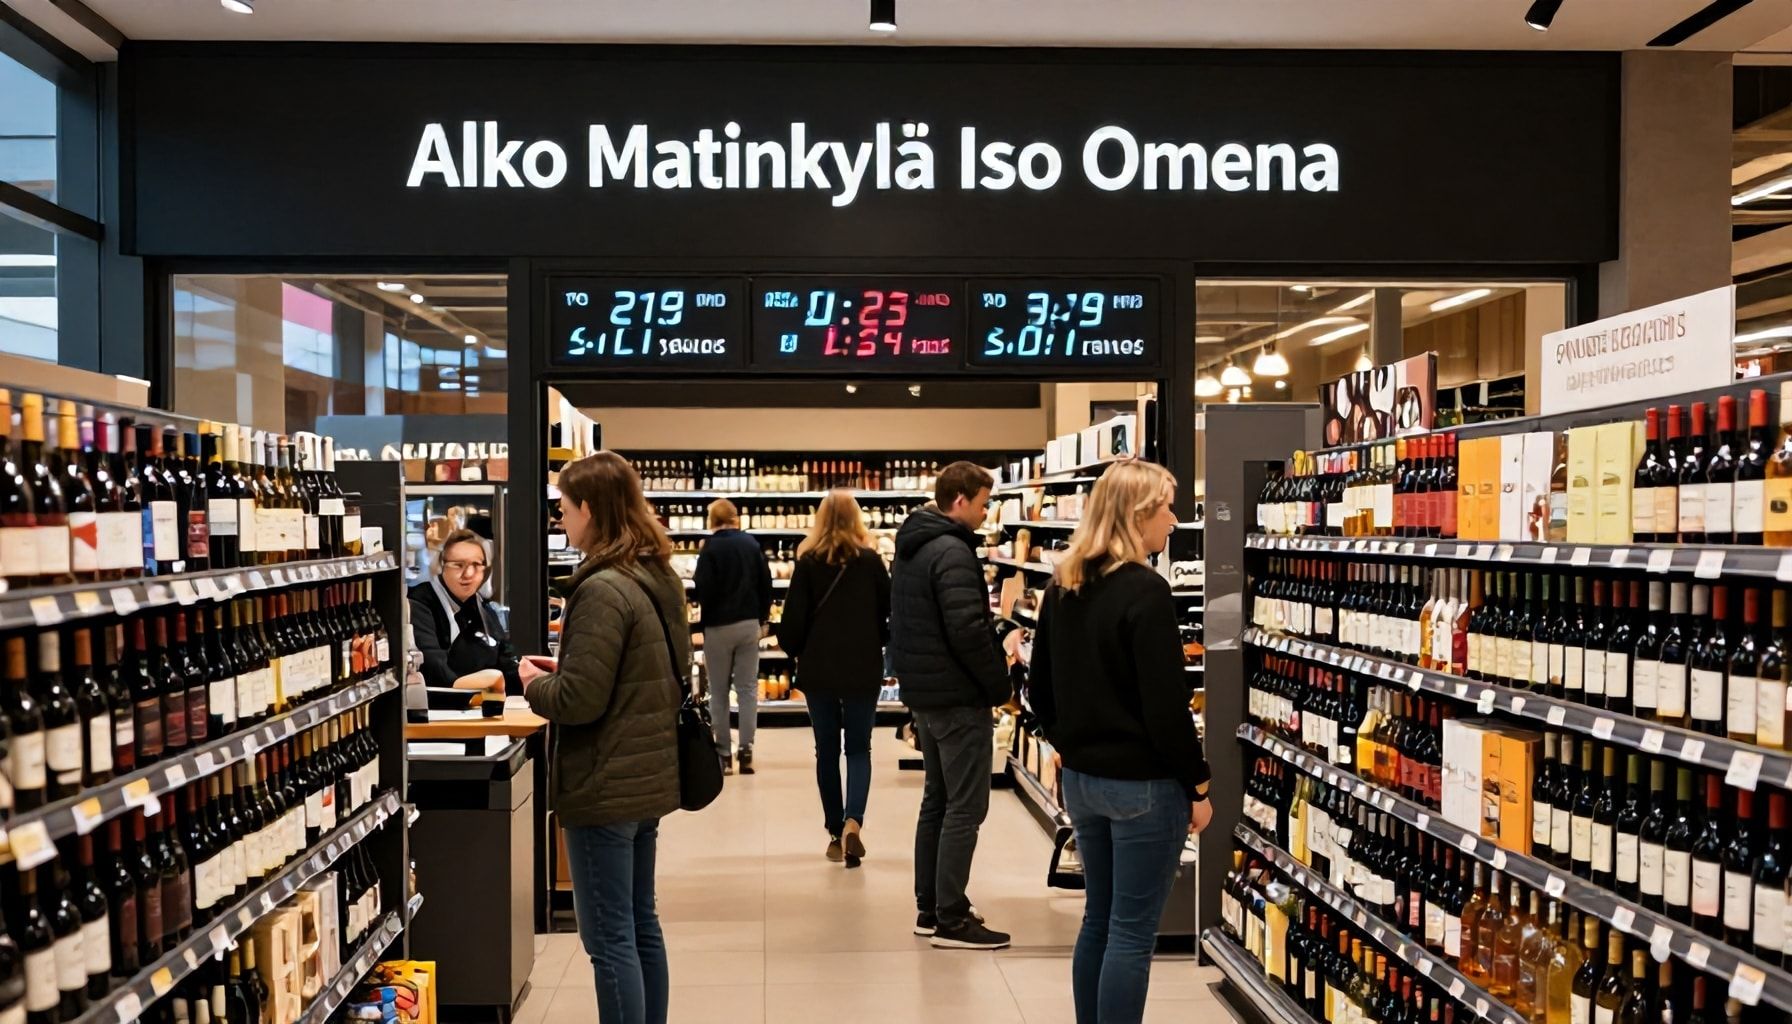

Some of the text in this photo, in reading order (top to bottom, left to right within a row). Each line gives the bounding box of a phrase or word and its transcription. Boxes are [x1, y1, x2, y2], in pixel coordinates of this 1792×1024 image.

[406, 121, 1340, 207] Alko Matinkylä Iso Omena
